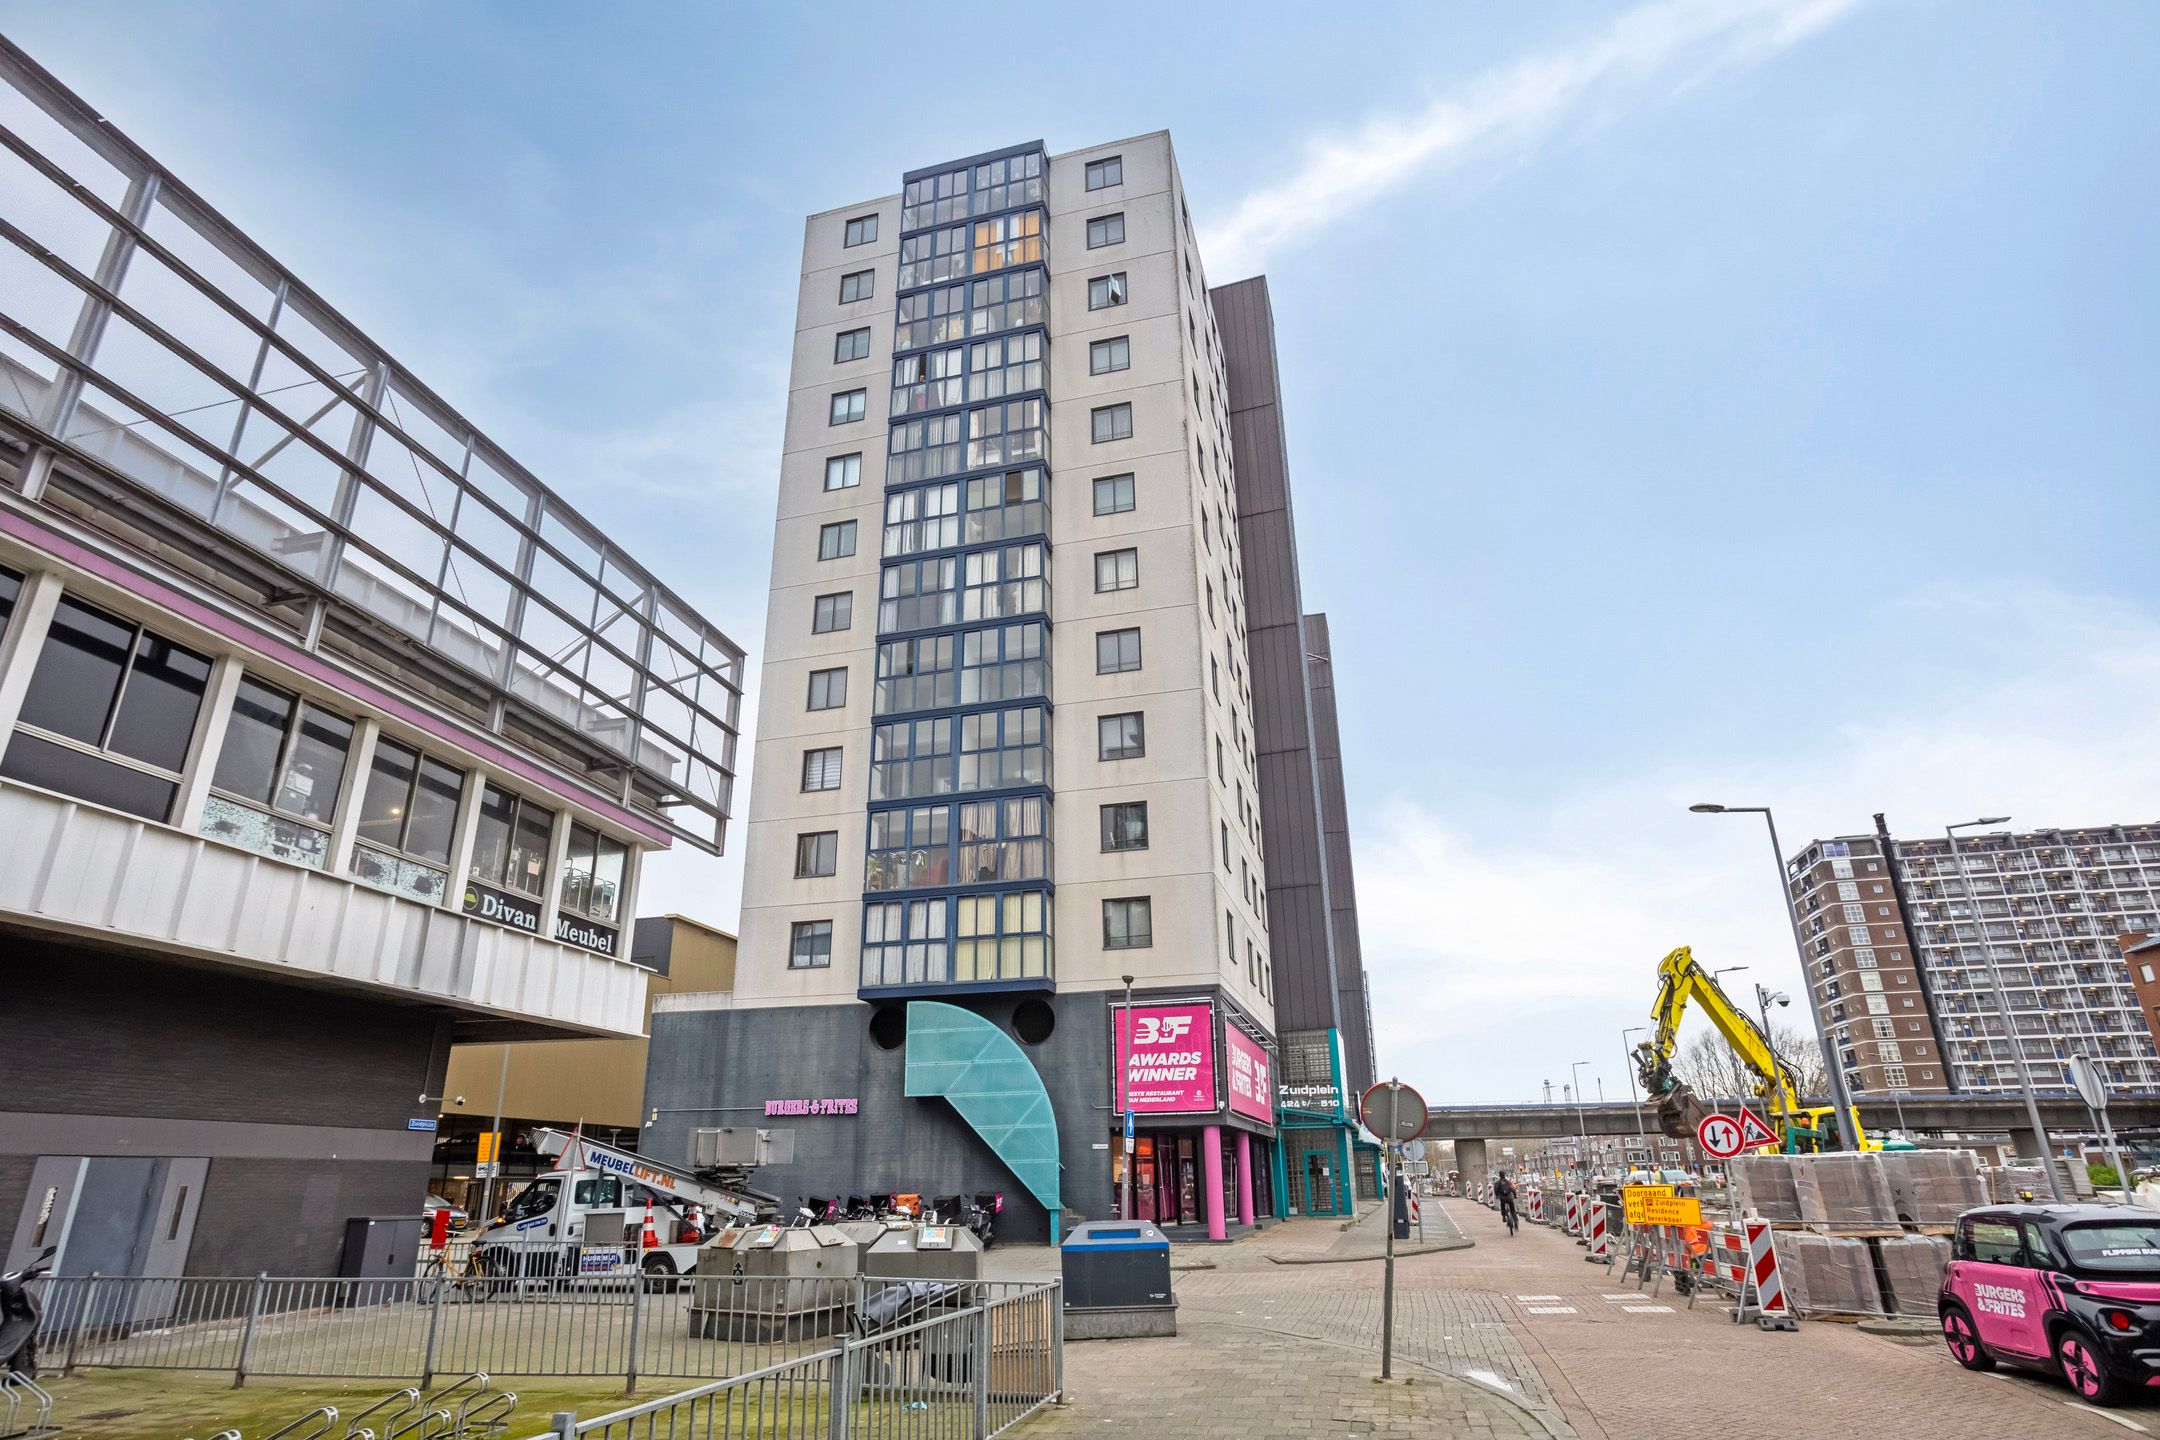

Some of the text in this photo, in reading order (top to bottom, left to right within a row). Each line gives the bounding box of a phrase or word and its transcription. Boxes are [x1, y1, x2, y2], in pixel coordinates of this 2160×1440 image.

[480, 894, 612, 953] Divan Meubel
[1129, 1051, 1202, 1067] AWARDS
[1128, 1067, 1198, 1082] WINNER
[1279, 1085, 1339, 1097] Zuidplein
[1281, 1100, 1300, 1108] 424
[1320, 1099, 1340, 1107] 510
[590, 1151, 677, 1190] MEUBELLIFT.NL
[1655, 1199, 1686, 1207] Zuidplein
[1646, 1207, 1680, 1215] Residence
[1647, 1215, 1683, 1223] bereikbaar
[2101, 1248, 2141, 1256] FLIPPING
[1974, 1283, 2026, 1304] BURGERS
